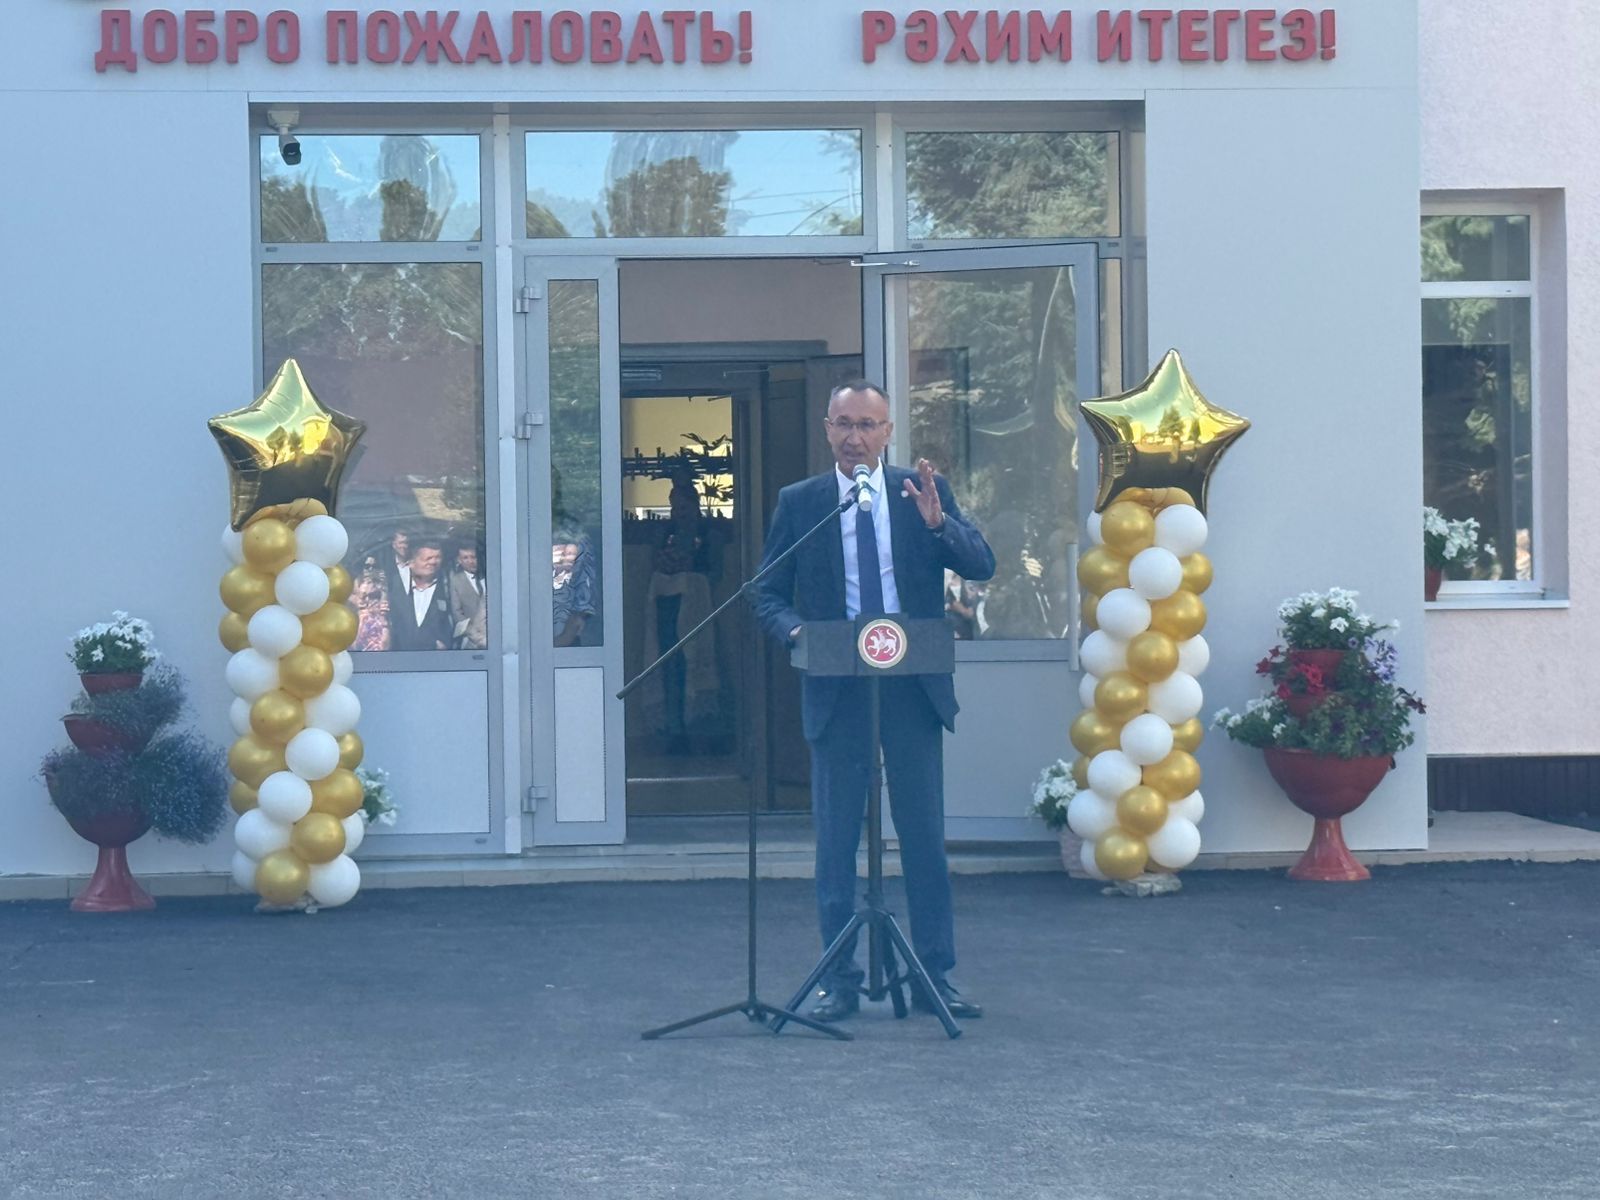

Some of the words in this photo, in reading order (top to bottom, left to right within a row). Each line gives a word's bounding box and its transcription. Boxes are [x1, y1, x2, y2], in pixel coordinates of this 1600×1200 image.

[95, 9, 300, 72] ДОБРО
[326, 11, 753, 64] ПОЖАЛОВАТЬ!
[861, 10, 1073, 63] РӘХИМ
[1096, 9, 1337, 62] ИТЕГЕЗ!
